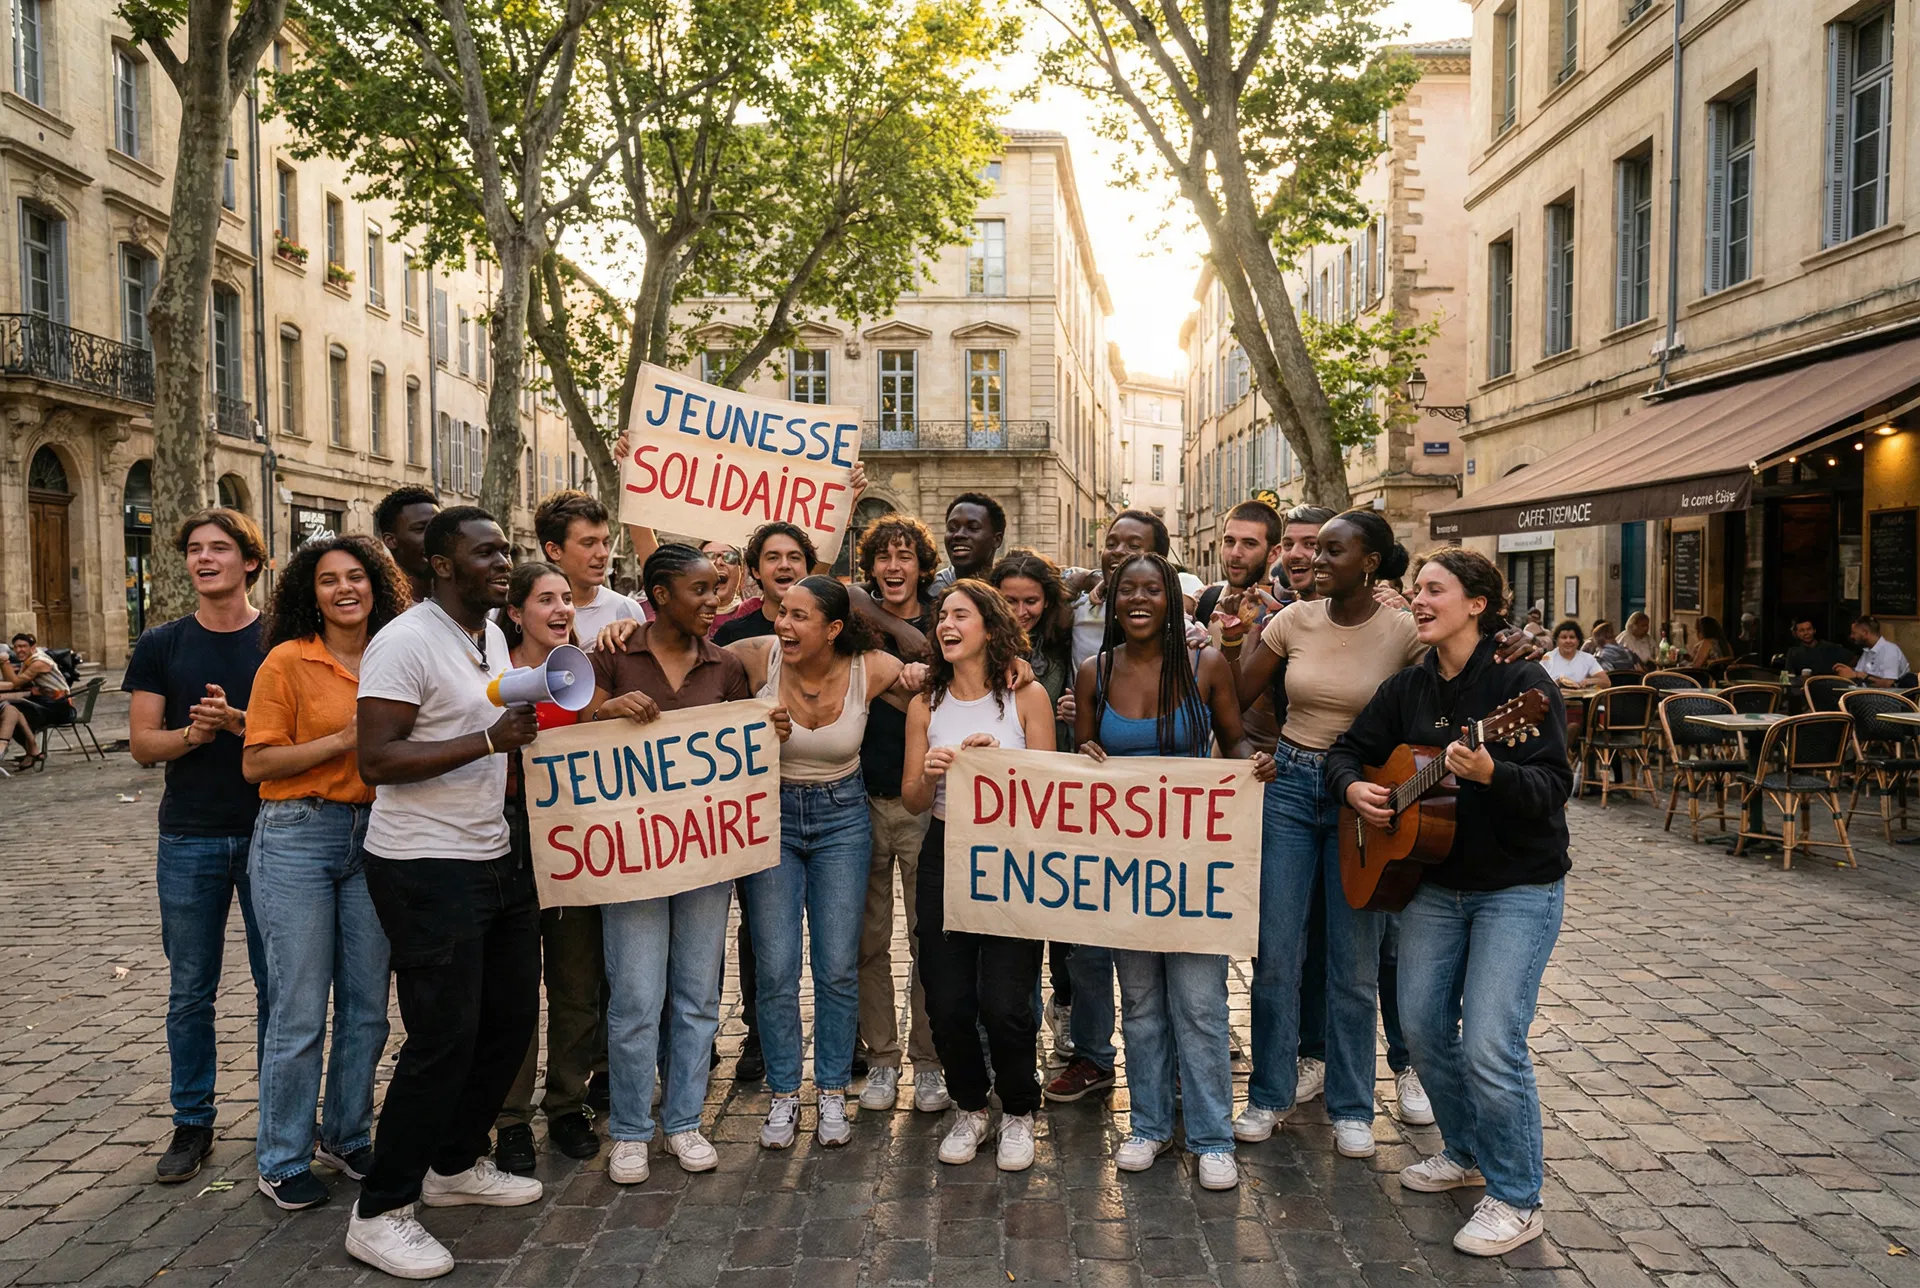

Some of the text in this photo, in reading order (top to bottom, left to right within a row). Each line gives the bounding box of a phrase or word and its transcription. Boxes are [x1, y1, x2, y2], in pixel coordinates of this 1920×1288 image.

[647, 383, 858, 468] JEUNESSE
[1518, 508, 1545, 528] CAFFE
[533, 722, 768, 807] JEUNESSE
[970, 845, 1234, 919] ENSEMBLE
